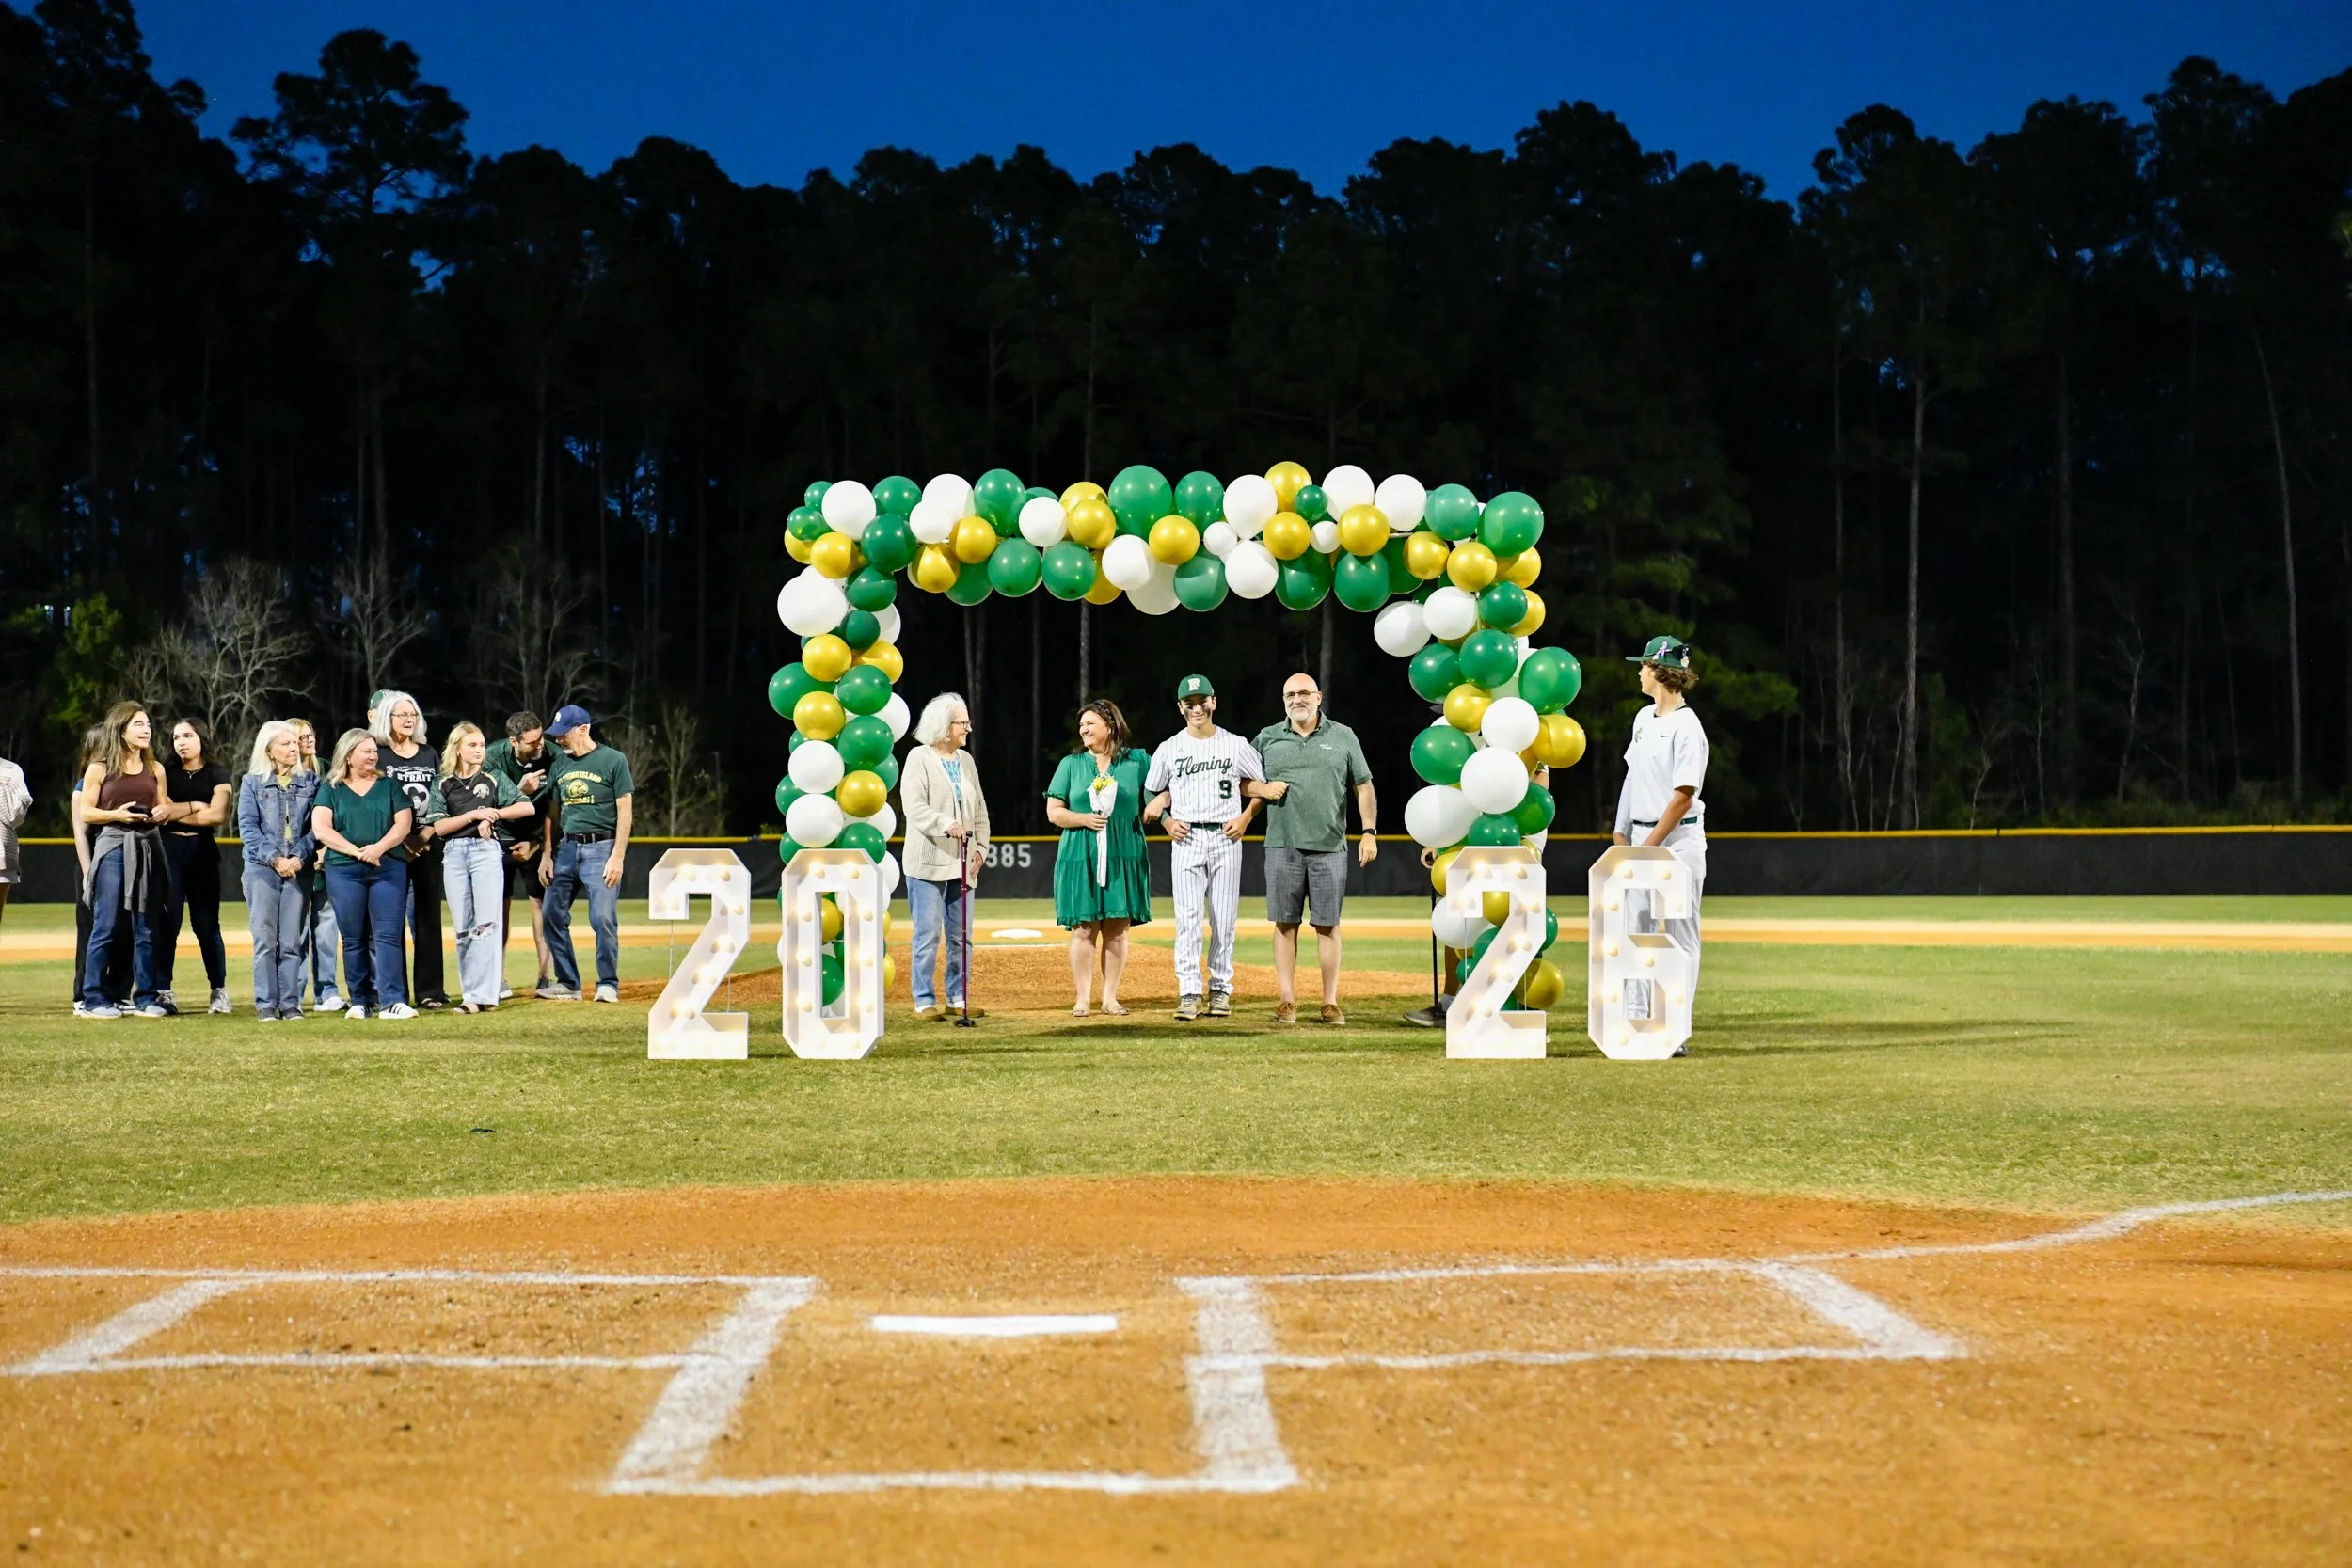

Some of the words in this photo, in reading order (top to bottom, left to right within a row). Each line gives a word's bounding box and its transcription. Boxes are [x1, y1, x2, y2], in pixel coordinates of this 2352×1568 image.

[1175, 756, 1232, 777] Fleming
[397, 773, 432, 782] STRAIT
[1219, 780, 1232, 799] 9
[985, 843, 1031, 868] 385
[647, 848, 884, 1060] 20
[1446, 846, 1692, 1060] 26
